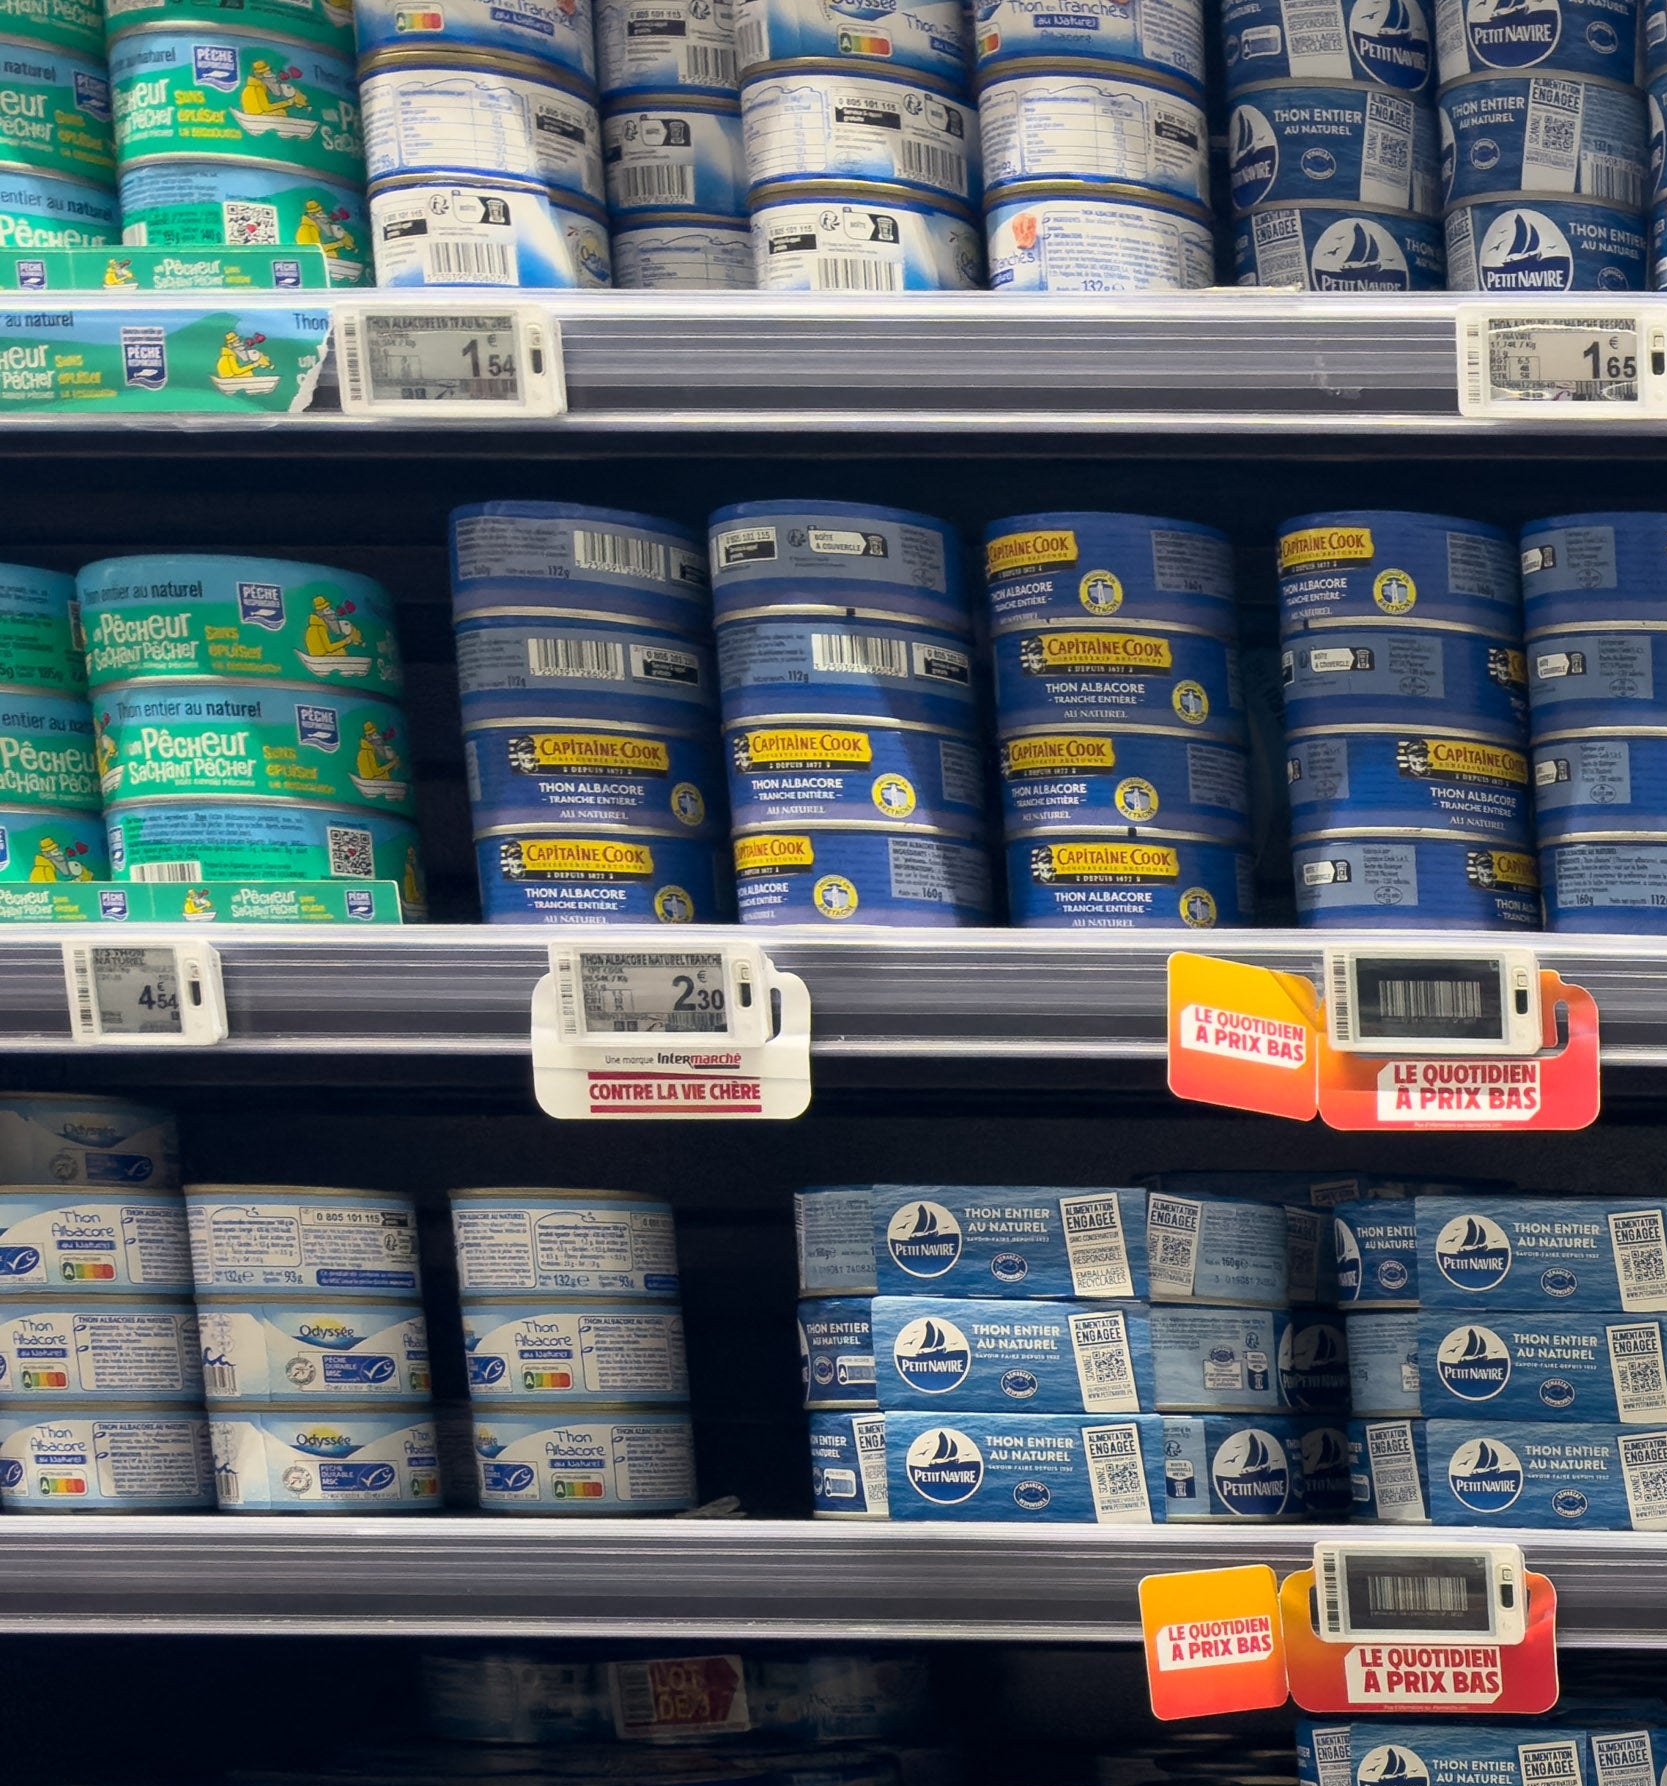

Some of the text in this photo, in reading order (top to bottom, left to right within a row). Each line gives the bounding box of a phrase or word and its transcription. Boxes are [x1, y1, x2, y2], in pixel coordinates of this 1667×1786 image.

[118, 704, 141, 720] Thon
[144, 703, 183, 718] entier
[206, 701, 261, 718] naturel
[540, 740, 659, 760] CAPITAINE COOK
[1394, 1064, 1537, 1085] LE QUOTIDIEN
[590, 1079, 760, 1101] CONTRE LA VIE CHÈRE
[1420, 1089, 1481, 1110] PRIX
[1488, 1089, 1536, 1110] BAS
[515, 1332, 572, 1346] Albacore
